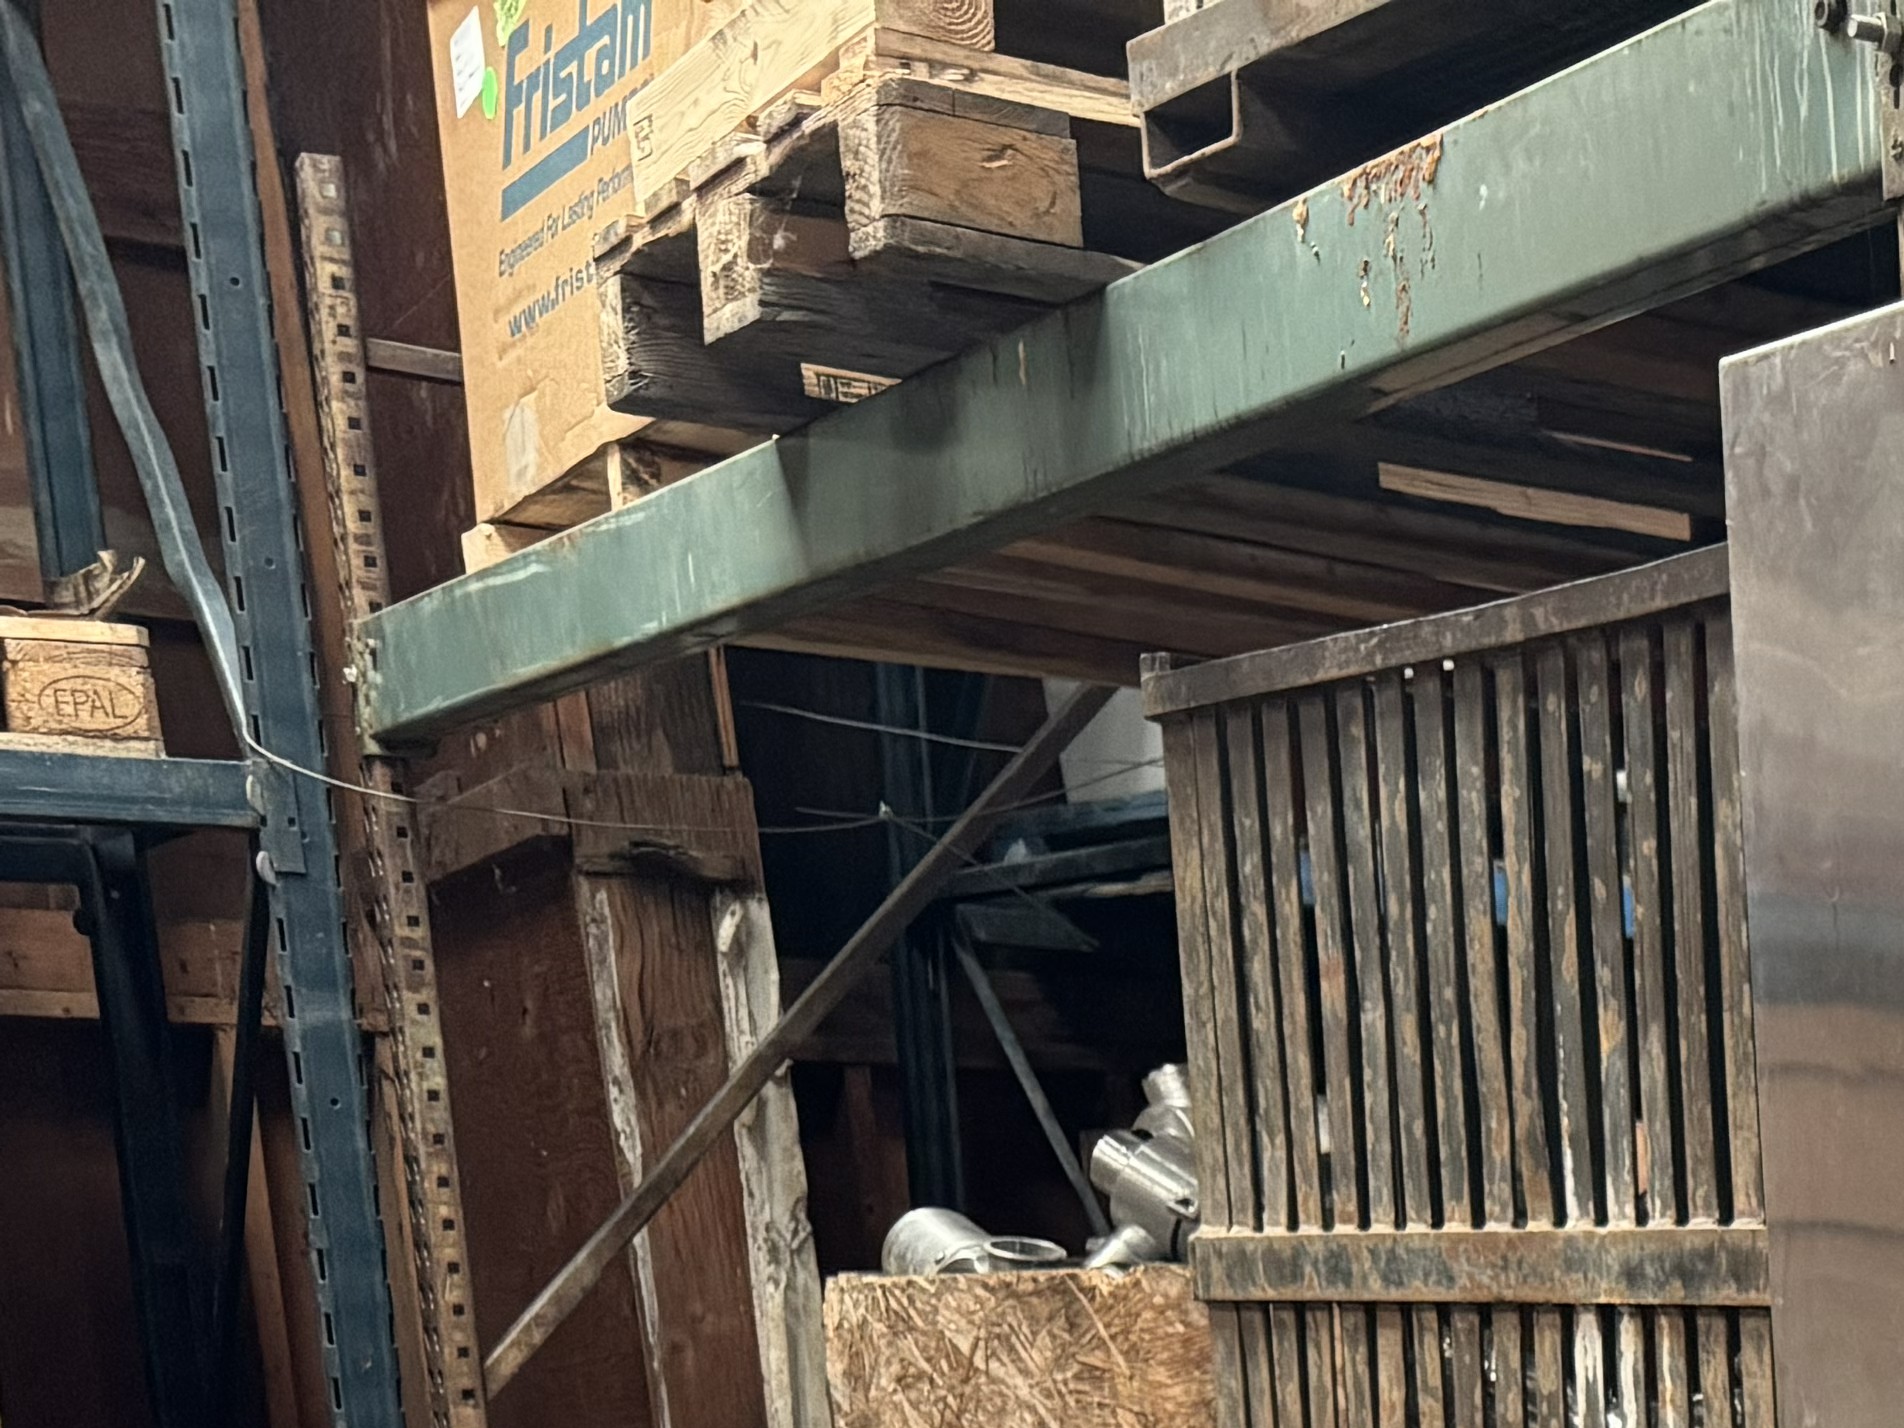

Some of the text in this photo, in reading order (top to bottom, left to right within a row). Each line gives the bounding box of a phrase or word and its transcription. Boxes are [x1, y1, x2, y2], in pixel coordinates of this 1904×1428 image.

[502, 0, 653, 171] Fristam
[499, 218, 546, 278] Engineered
[561, 189, 595, 232] Lasting
[508, 258, 595, 338] www.frist
[53, 687, 129, 720] EPAL
